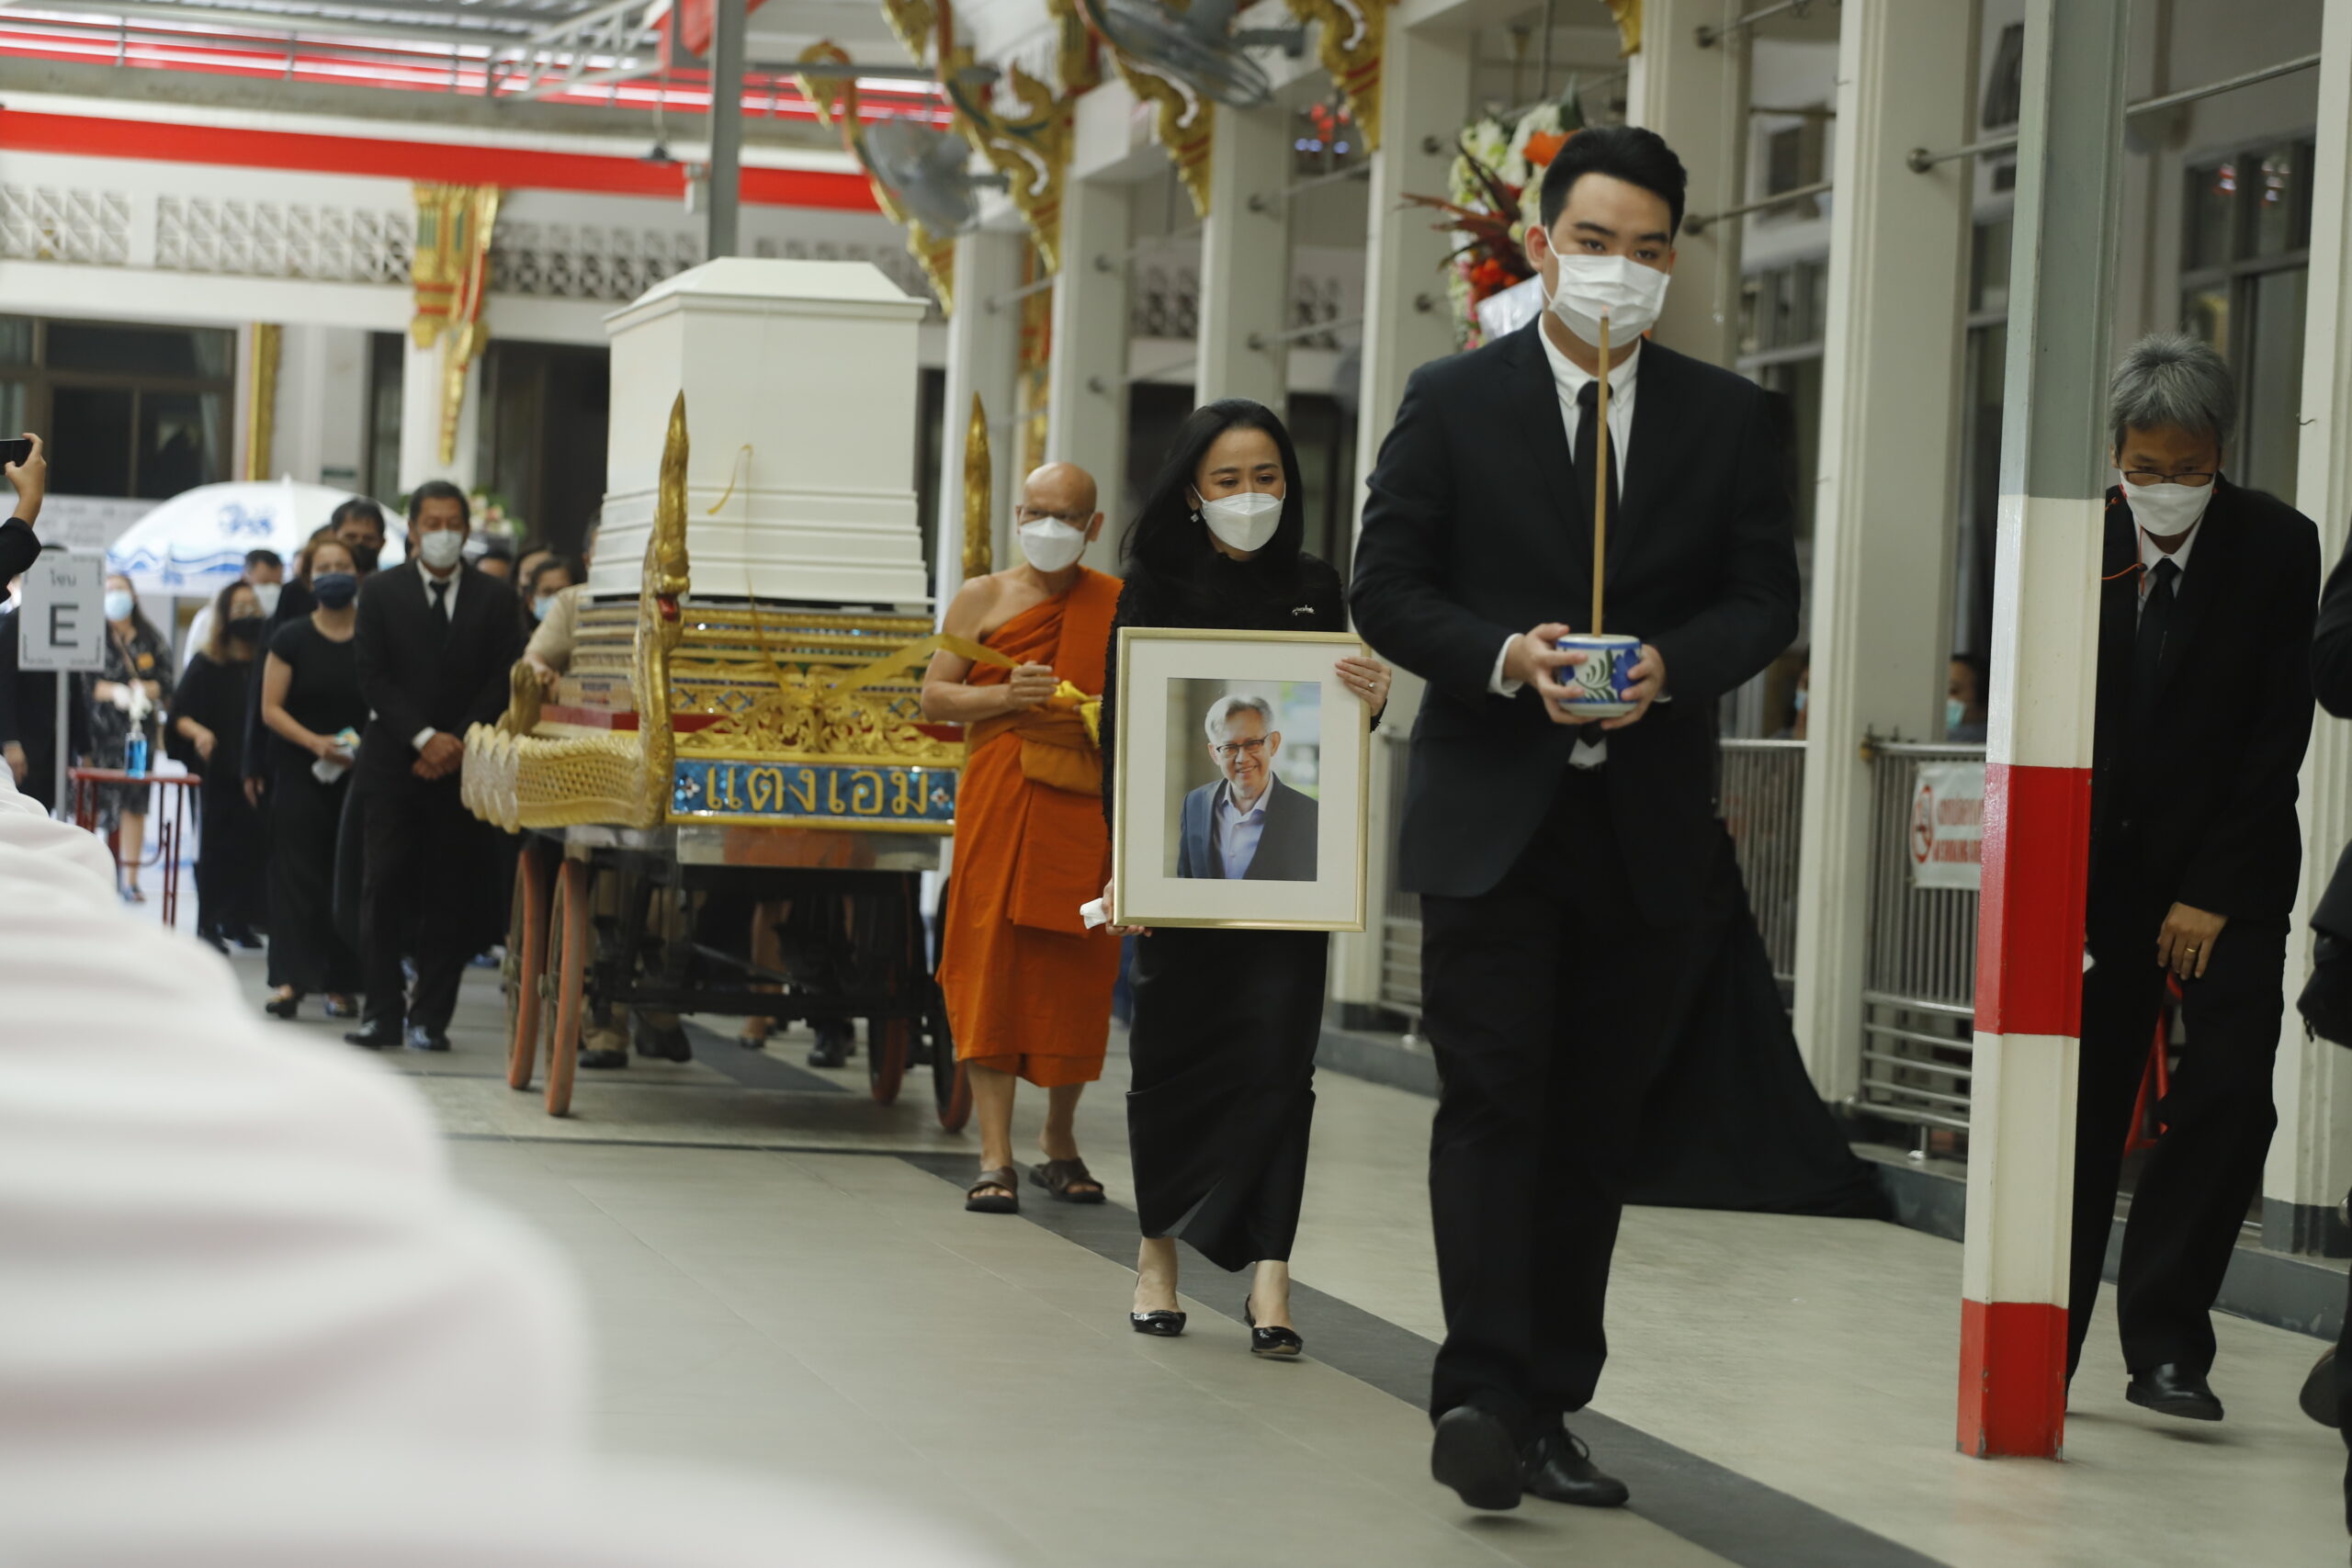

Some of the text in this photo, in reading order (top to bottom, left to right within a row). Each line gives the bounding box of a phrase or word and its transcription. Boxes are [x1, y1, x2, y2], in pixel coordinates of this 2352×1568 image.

[50, 604, 79, 648] E
[706, 766, 929, 816] แตงเอม
